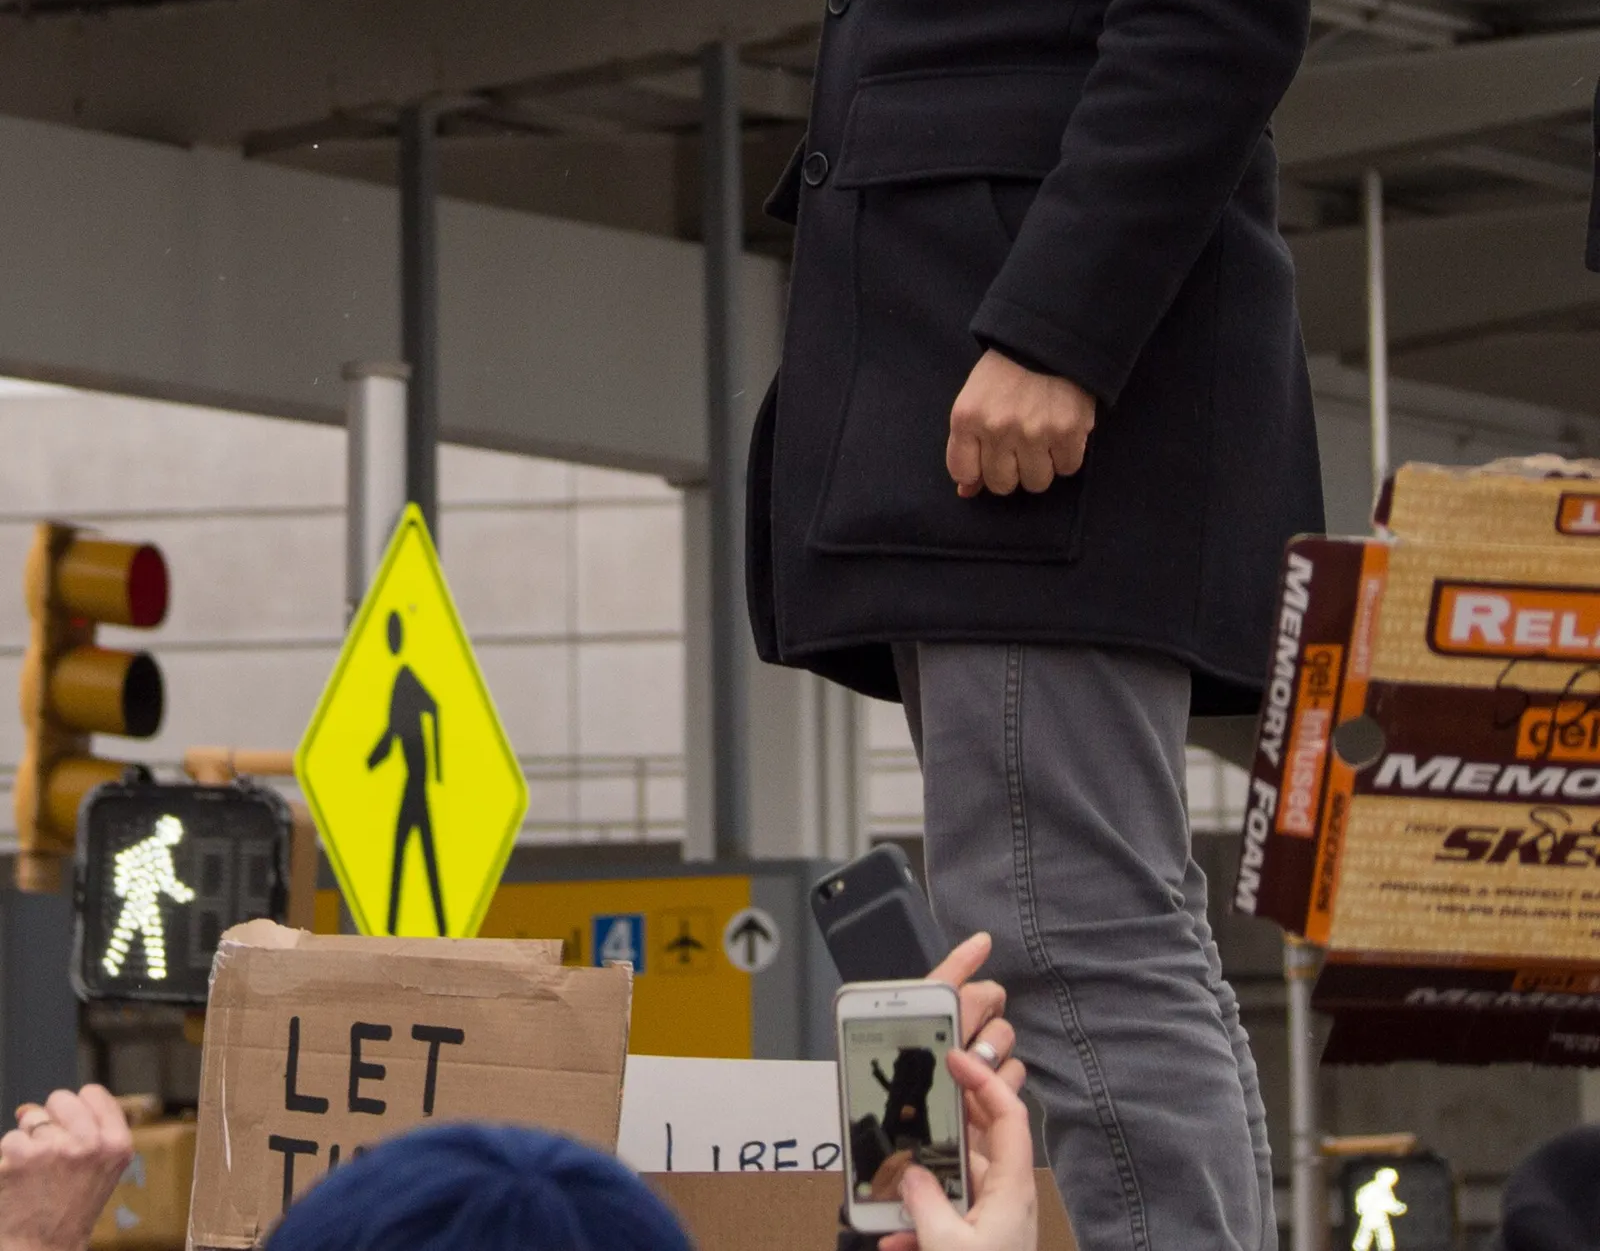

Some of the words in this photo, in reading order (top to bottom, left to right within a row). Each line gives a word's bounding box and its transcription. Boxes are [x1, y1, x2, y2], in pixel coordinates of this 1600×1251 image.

[1260, 552, 1313, 768] MEMORY
[1235, 777, 1278, 915] FOAM
[1434, 824, 1600, 867] SKE
[602, 918, 635, 962] 4
[284, 1016, 465, 1117] LET
